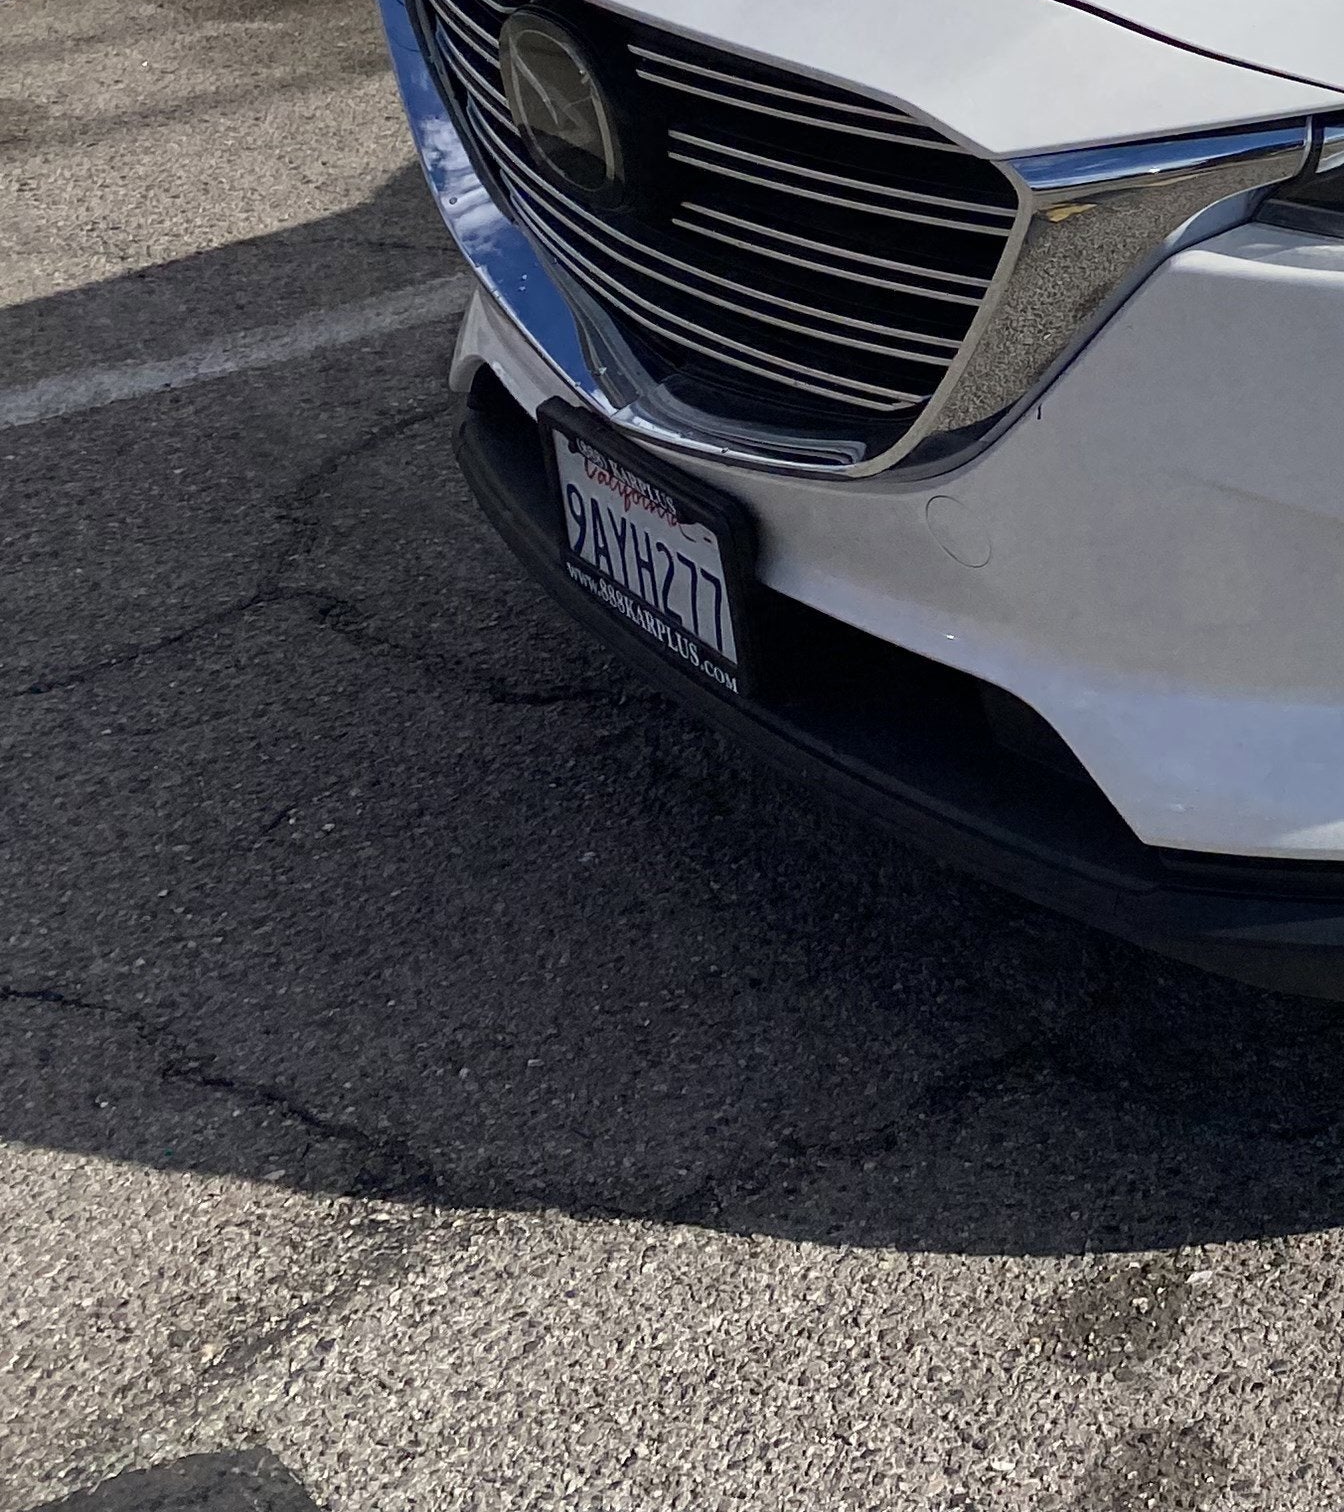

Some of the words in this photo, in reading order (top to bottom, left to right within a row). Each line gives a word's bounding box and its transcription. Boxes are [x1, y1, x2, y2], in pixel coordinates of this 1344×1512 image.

[584, 456, 696, 543] California
[608, 458, 677, 516] KARPLUS
[566, 482, 723, 653] 9AYH277
